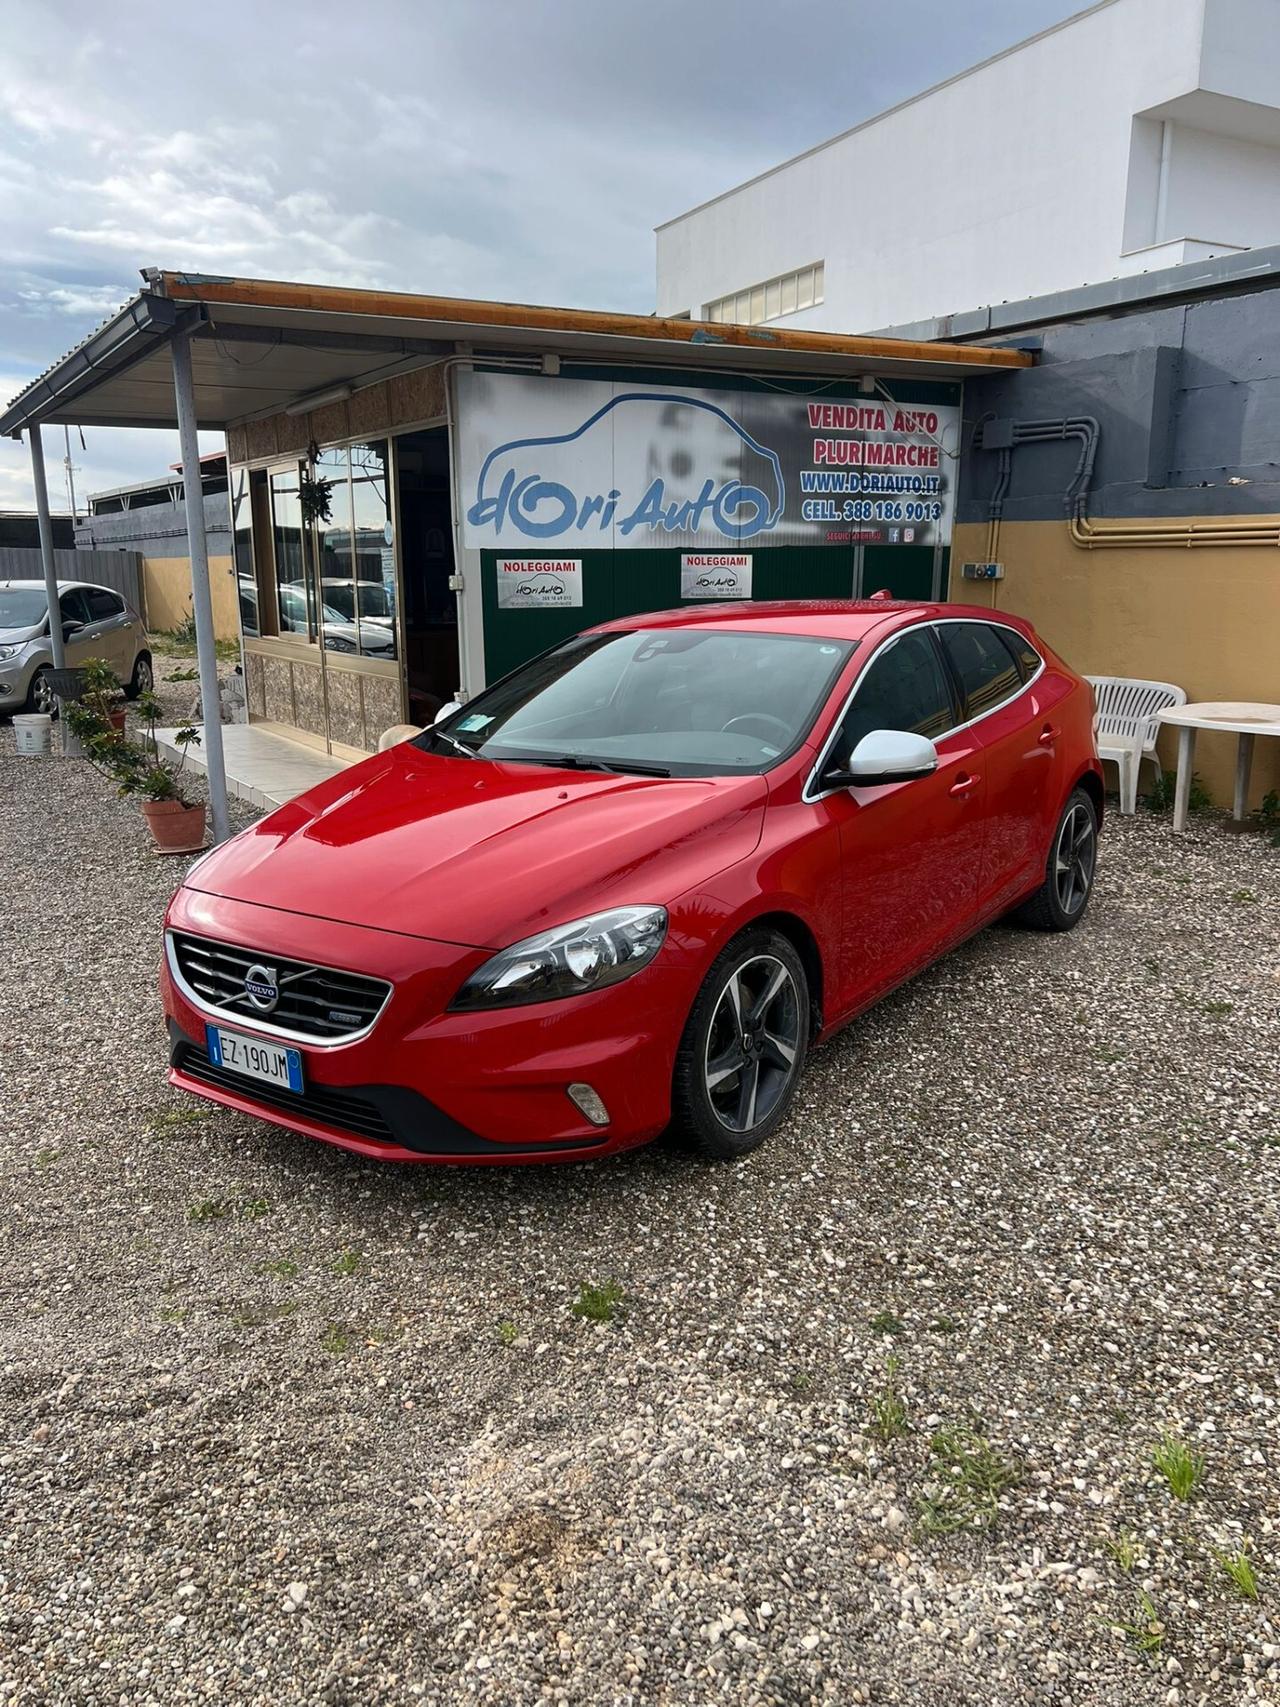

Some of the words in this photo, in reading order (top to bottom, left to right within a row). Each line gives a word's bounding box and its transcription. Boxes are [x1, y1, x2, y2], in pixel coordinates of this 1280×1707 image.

[808, 404, 886, 431] VENDITA
[893, 410, 938, 434] AUTO
[814, 440, 938, 467] PLURIMARCHE
[800, 471, 939, 495] WWW.DORIAUTO.IT
[802, 500, 842, 521] CELL.
[844, 501, 872, 521] 388
[876, 501, 902, 521] 186
[906, 502, 941, 521] 9013
[504, 562, 576, 572] NOLEGGIAMI
[687, 556, 747, 566] NOLEGGIAMI
[246, 982, 275, 997] VOLVO
[221, 1036, 239, 1065] EZ
[243, 1044, 289, 1081] 190JM
